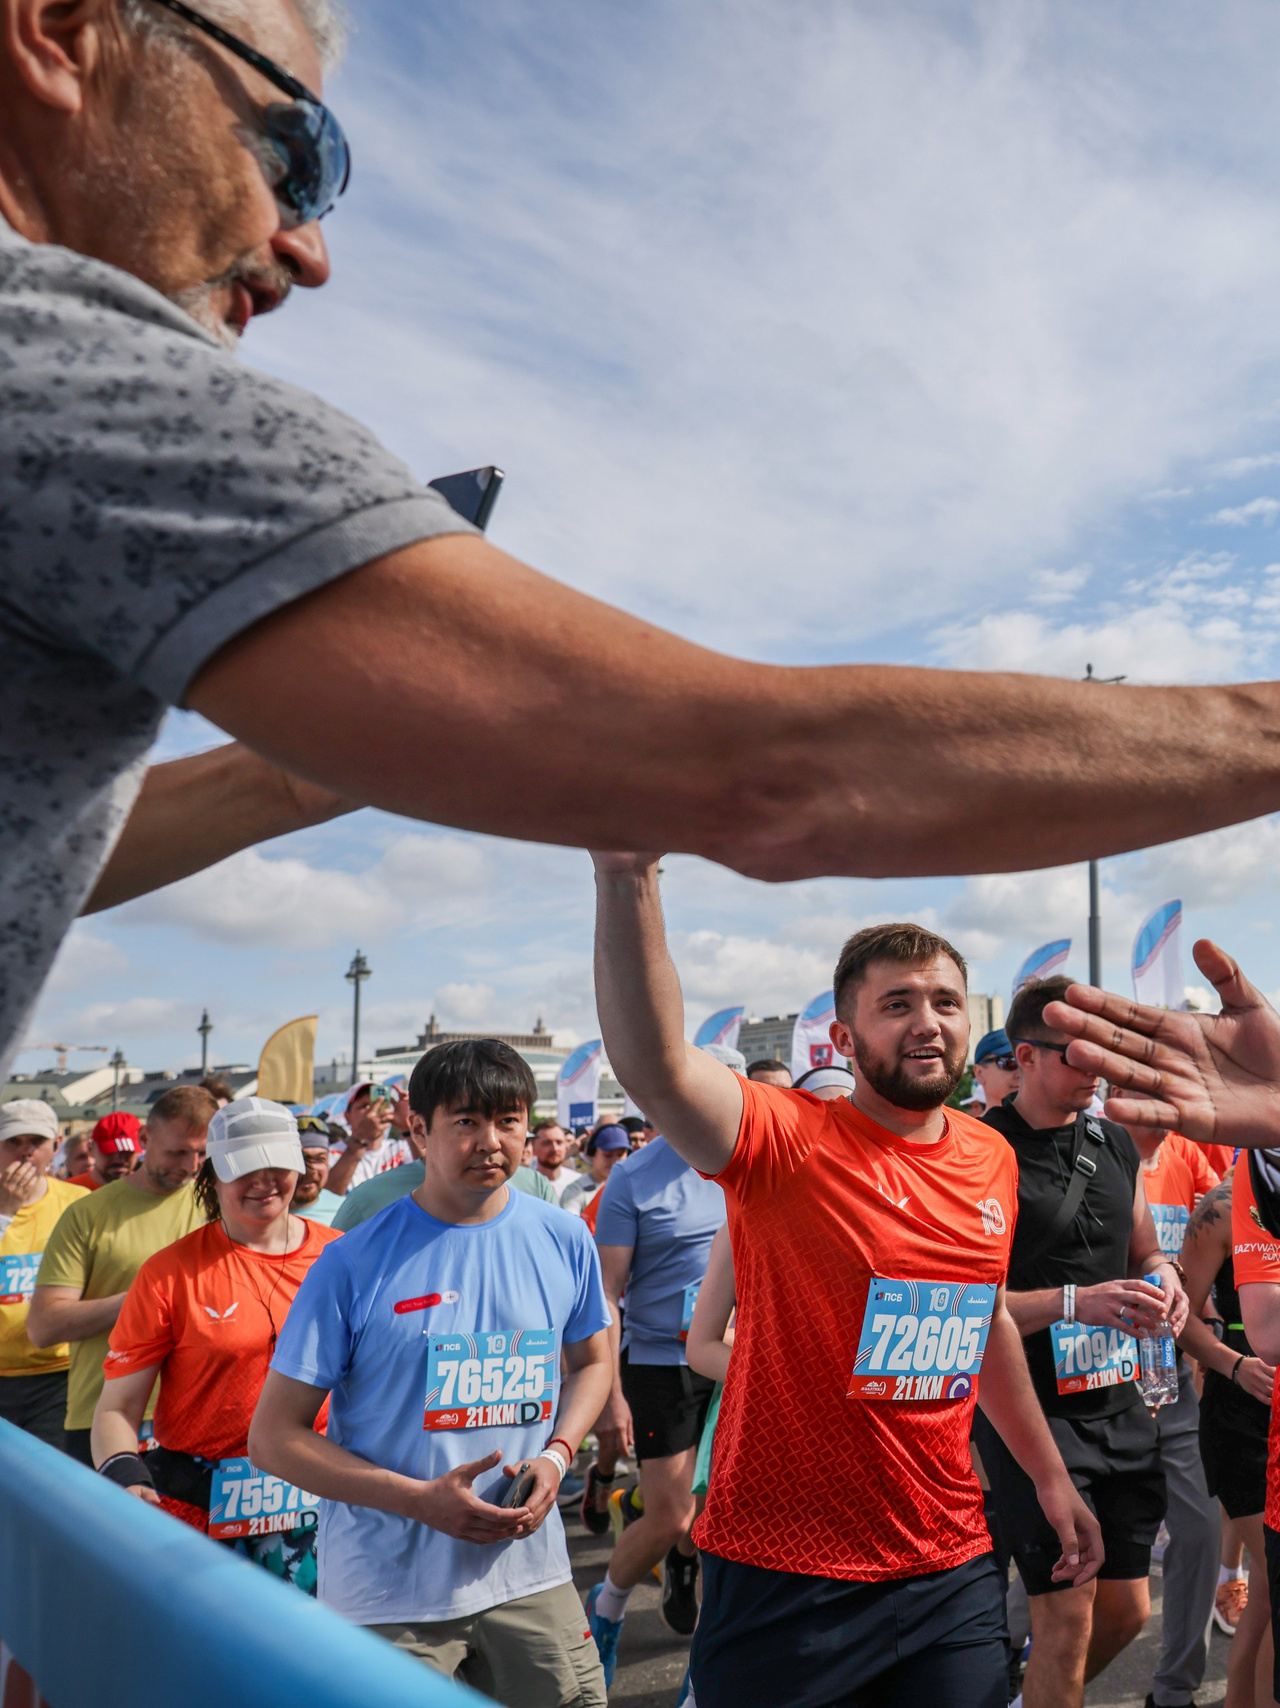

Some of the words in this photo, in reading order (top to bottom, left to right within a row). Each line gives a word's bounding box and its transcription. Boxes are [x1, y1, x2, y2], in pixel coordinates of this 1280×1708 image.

[976, 1198, 1006, 1235] 10
[1261, 1252, 1280, 1261] RUN
[884, 1292, 903, 1302] ПСБ
[930, 1287, 950, 1312] 10
[443, 1343, 461, 1352] ПСБ
[486, 1334, 506, 1355] 10
[868, 1313, 983, 1372] 72605
[437, 1354, 546, 1406] 76525
[1086, 1368, 1119, 1390] 21.1KM
[1121, 1359, 1133, 1378] D
[892, 1375, 944, 1400] 21.1KM
[465, 1403, 516, 1428] 21.1KM
[520, 1402, 540, 1423] D
[248, 1511, 296, 1536] 21.1KM
